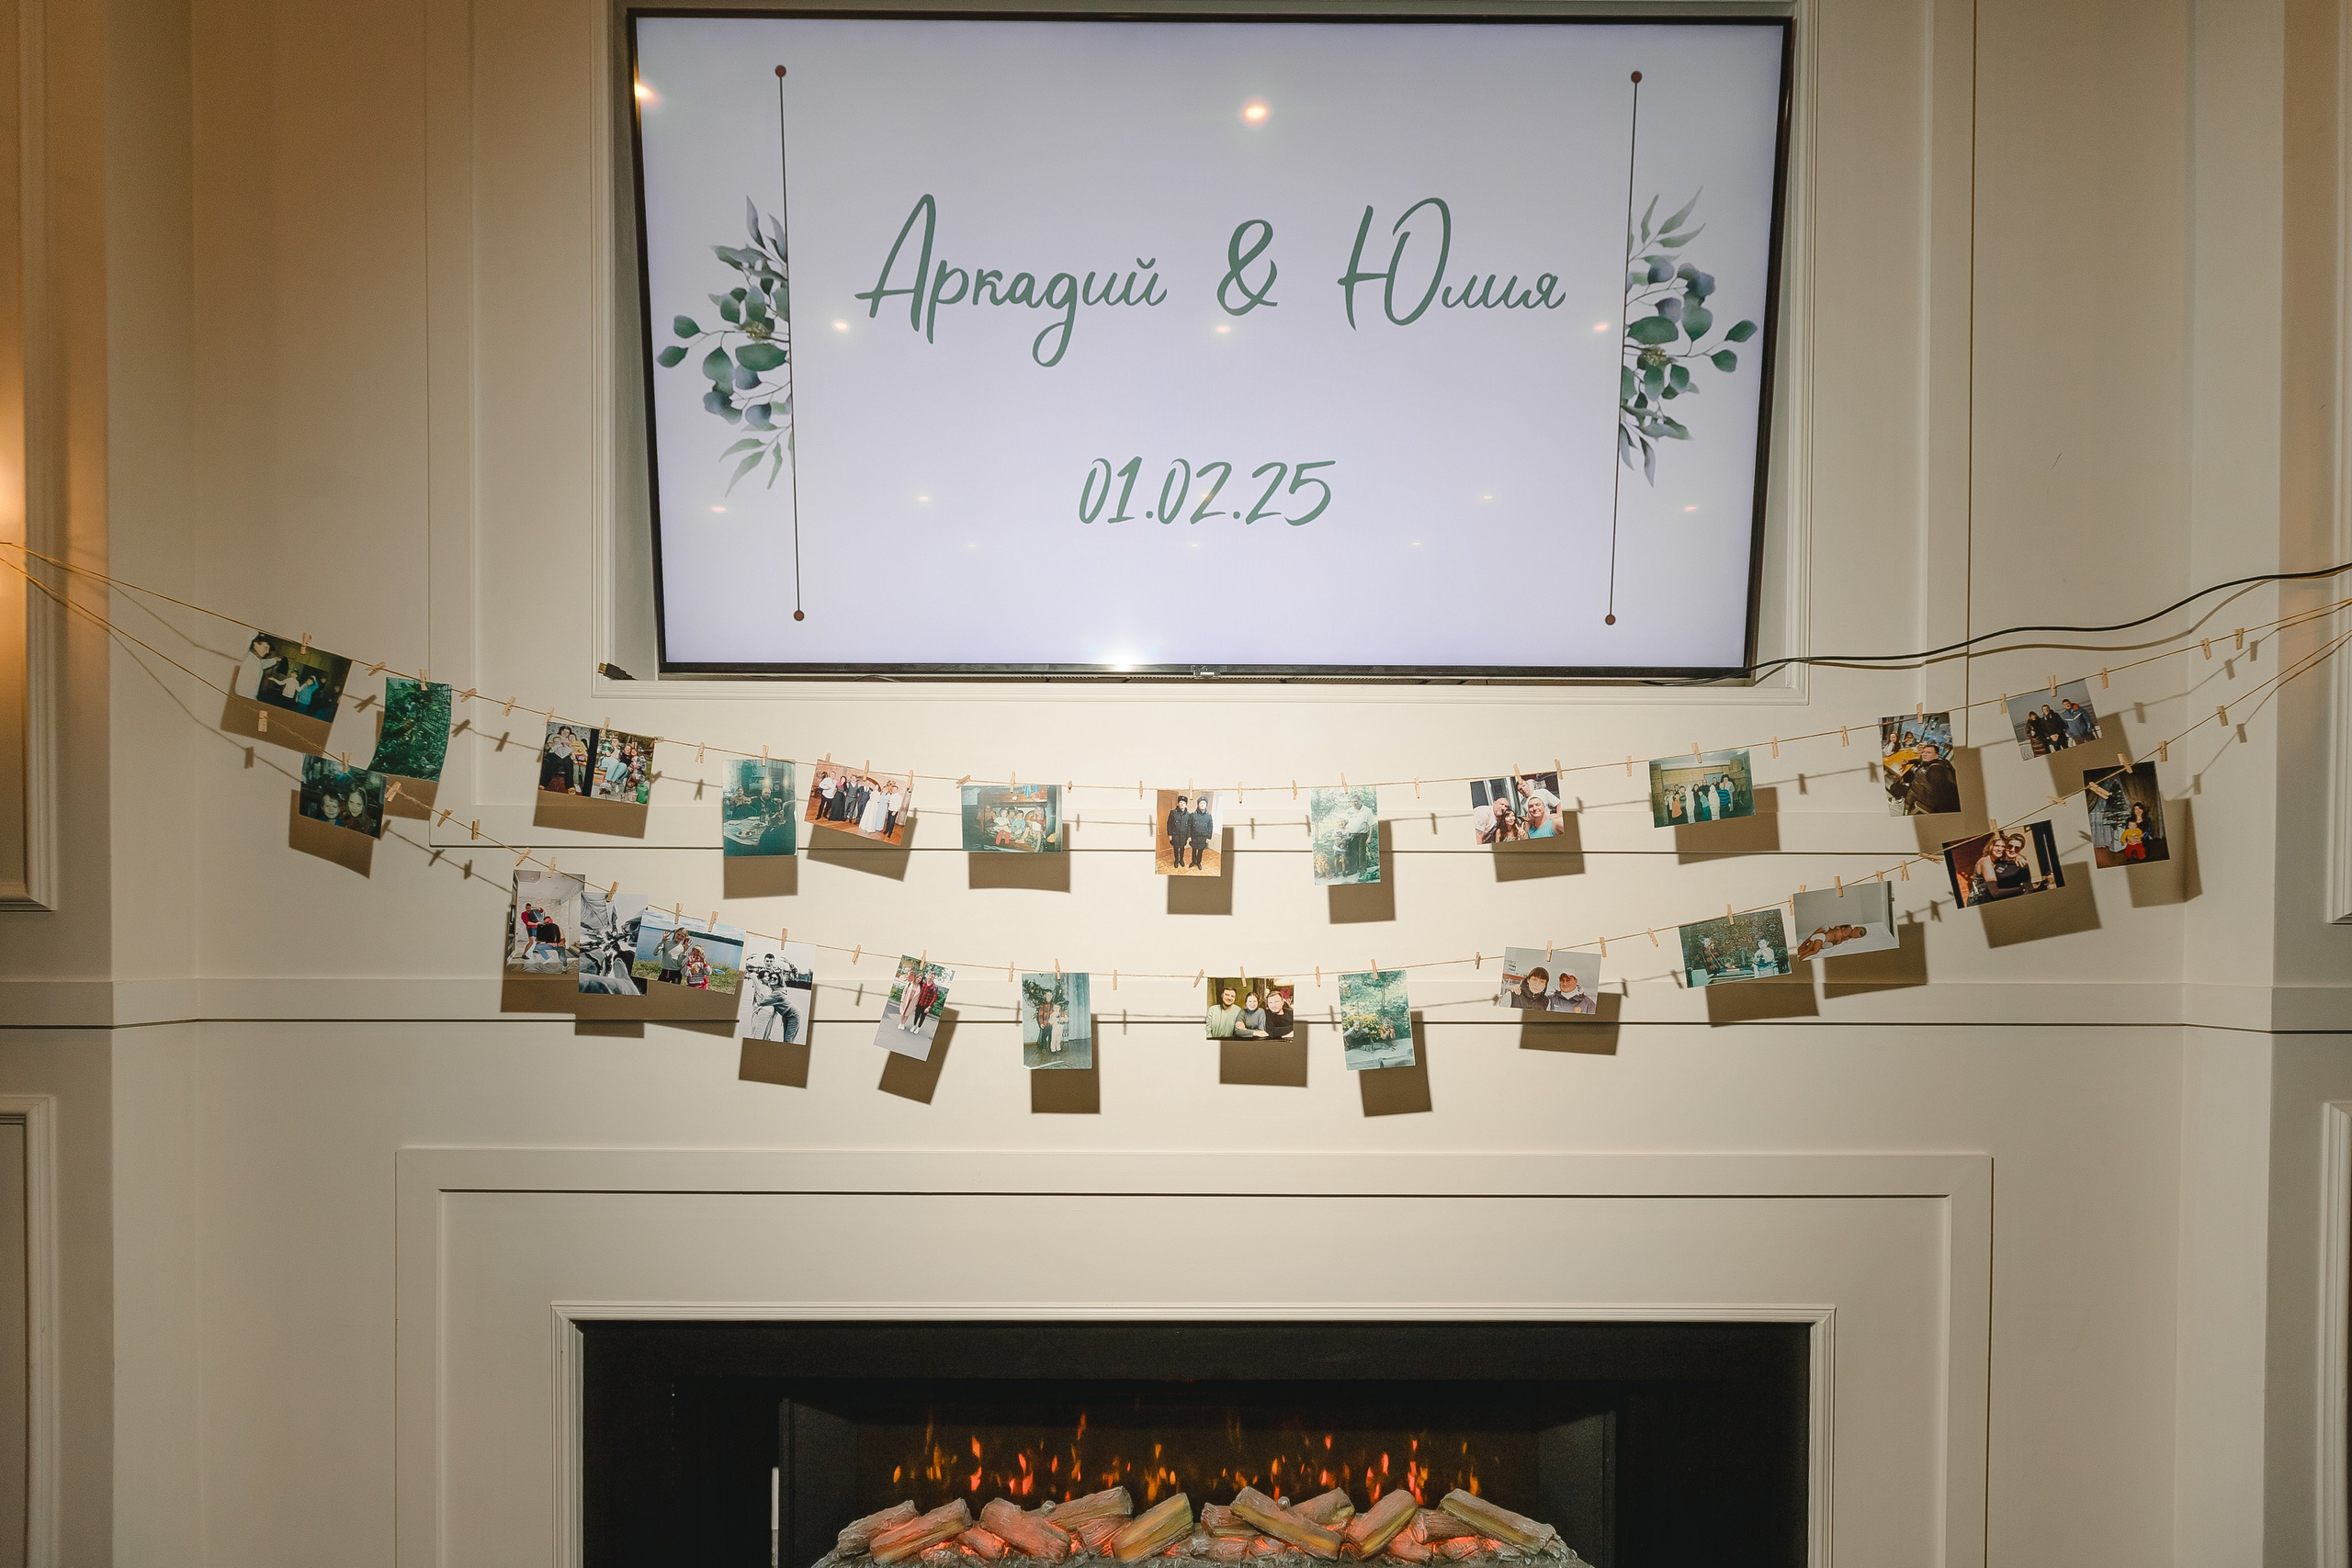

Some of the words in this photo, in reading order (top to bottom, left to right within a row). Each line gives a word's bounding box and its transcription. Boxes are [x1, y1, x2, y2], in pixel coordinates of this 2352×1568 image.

[854, 194, 1168, 367] Аркадий
[1216, 219, 1279, 316] &
[1338, 197, 1566, 330] Юлия
[1078, 457, 1336, 526] 01.02.25
